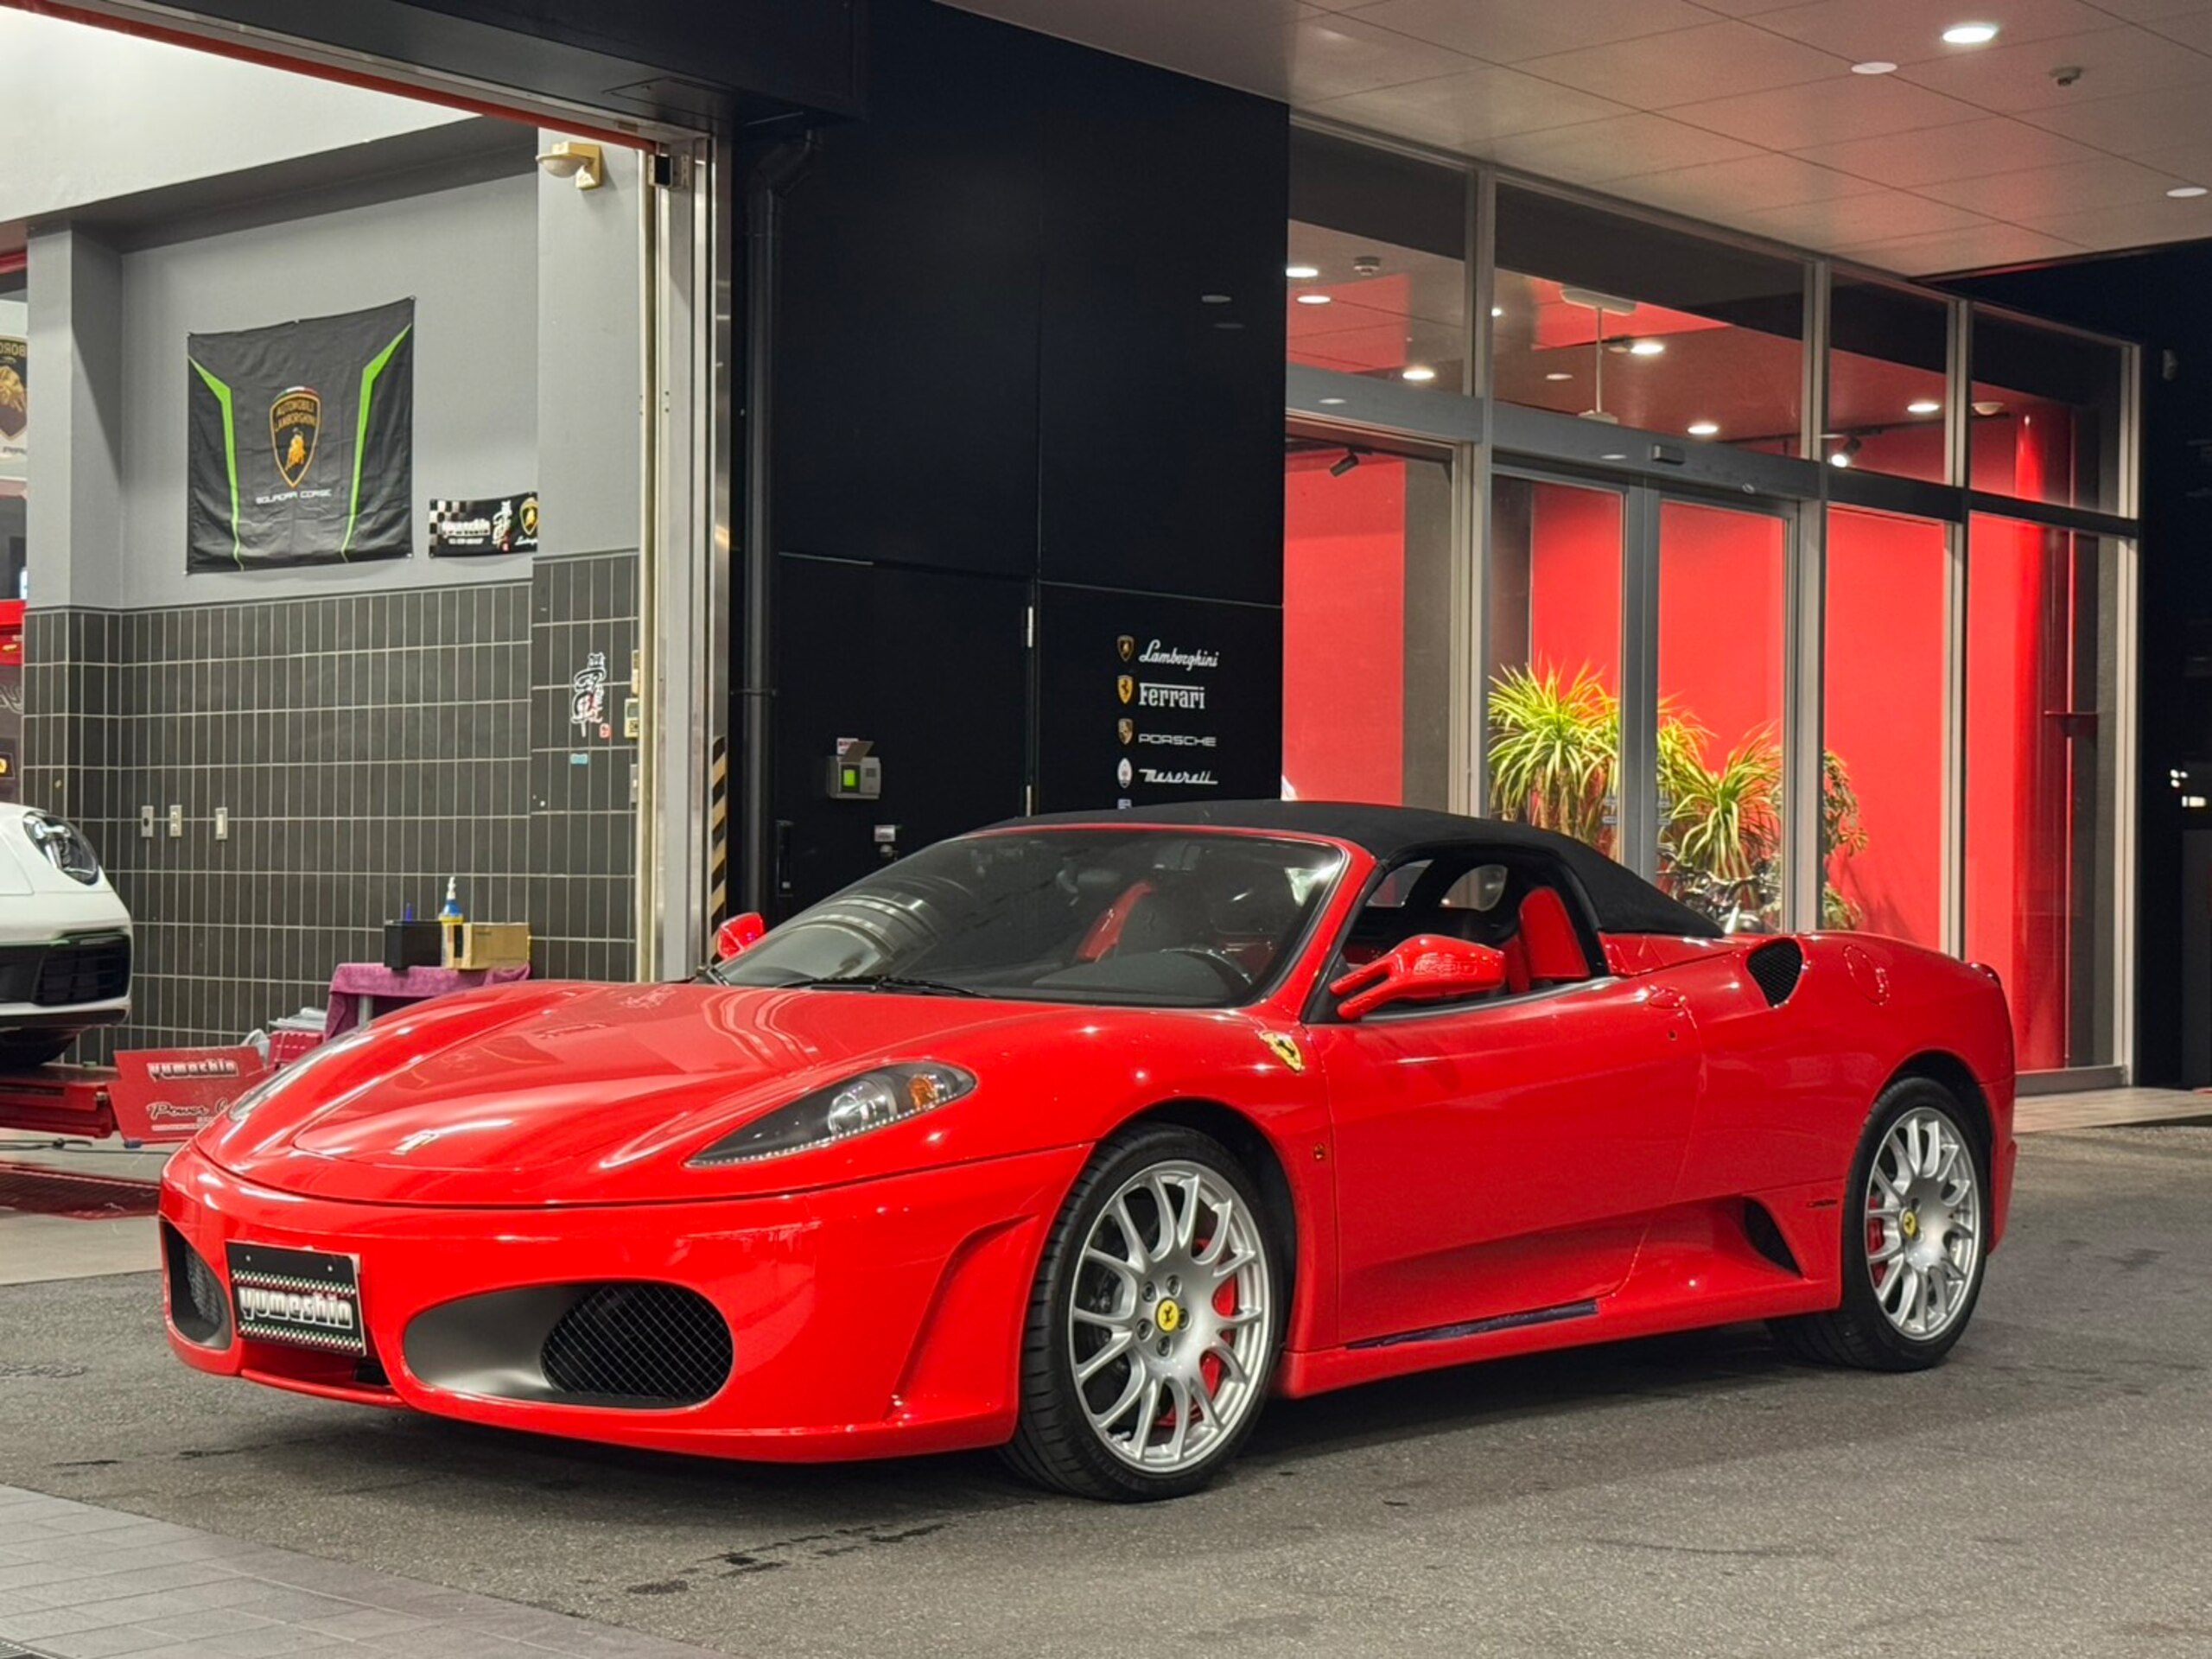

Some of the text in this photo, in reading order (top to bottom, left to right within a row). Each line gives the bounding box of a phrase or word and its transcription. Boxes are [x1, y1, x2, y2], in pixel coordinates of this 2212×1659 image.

[1138, 639, 1219, 671] Lamborghini
[1138, 682, 1205, 709] Ferrari
[1138, 733, 1217, 747] PORSCHE
[1138, 768, 1219, 785] Maserati
[145, 1101, 210, 1121] Power
[238, 1287, 353, 1331] yumeshin
